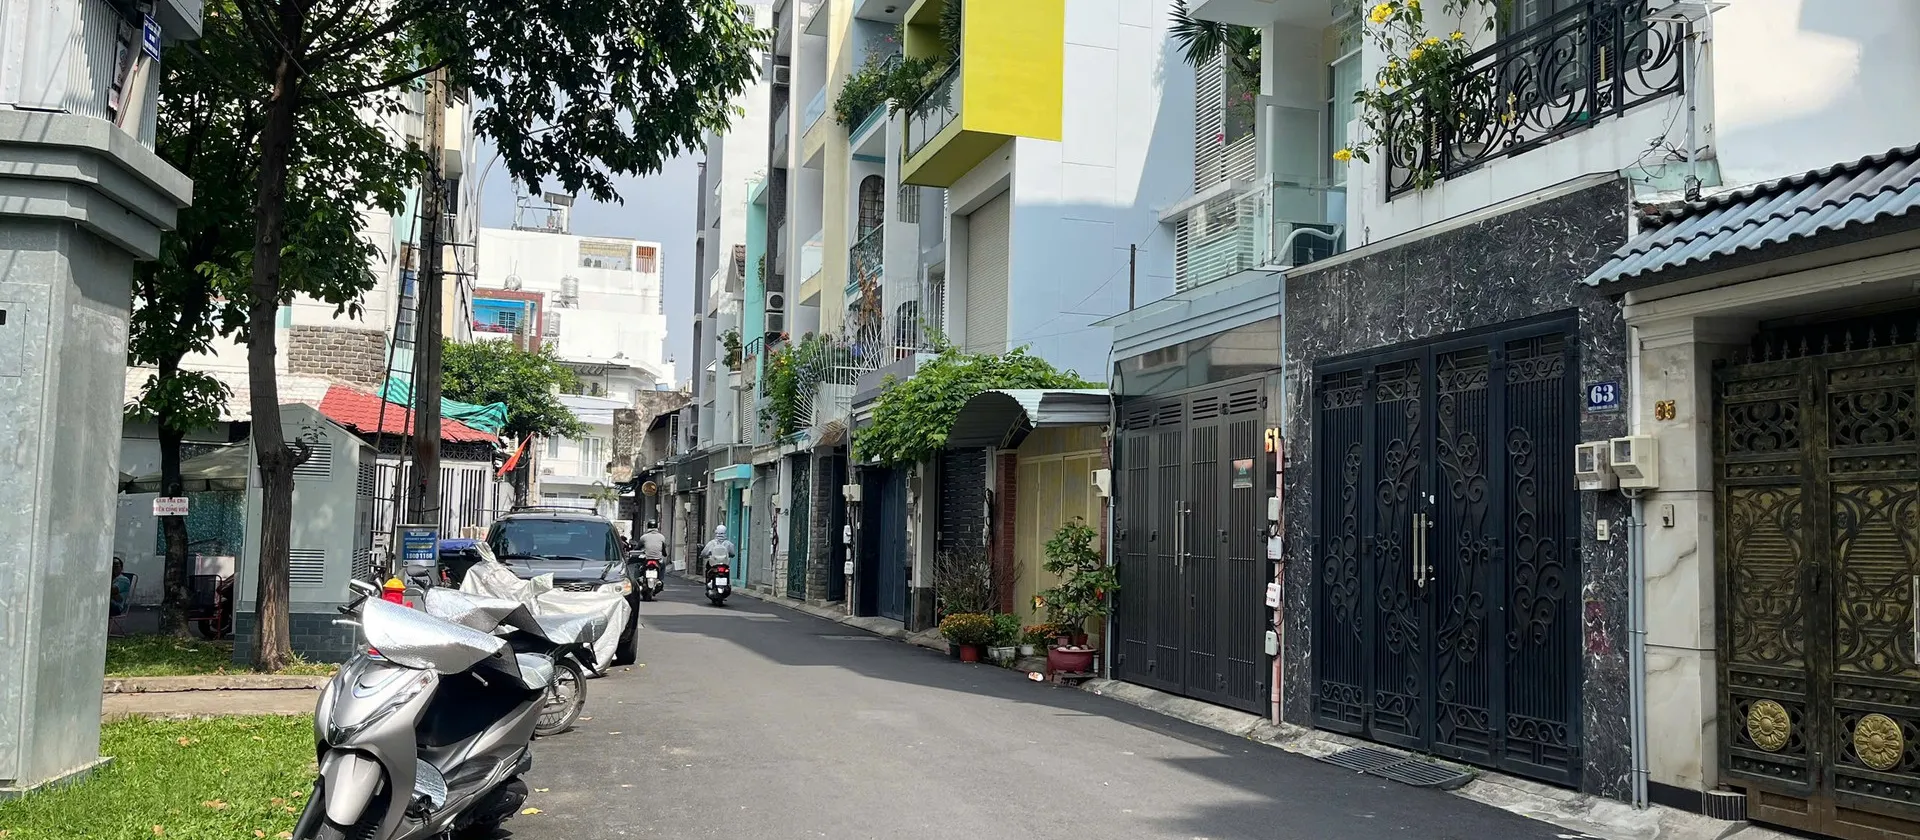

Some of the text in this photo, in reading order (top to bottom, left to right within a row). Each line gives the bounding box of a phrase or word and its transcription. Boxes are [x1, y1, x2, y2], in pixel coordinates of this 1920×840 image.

[1591, 384, 1614, 404] 63
[1655, 400, 1676, 421] 65
[1265, 427, 1280, 453] 61
